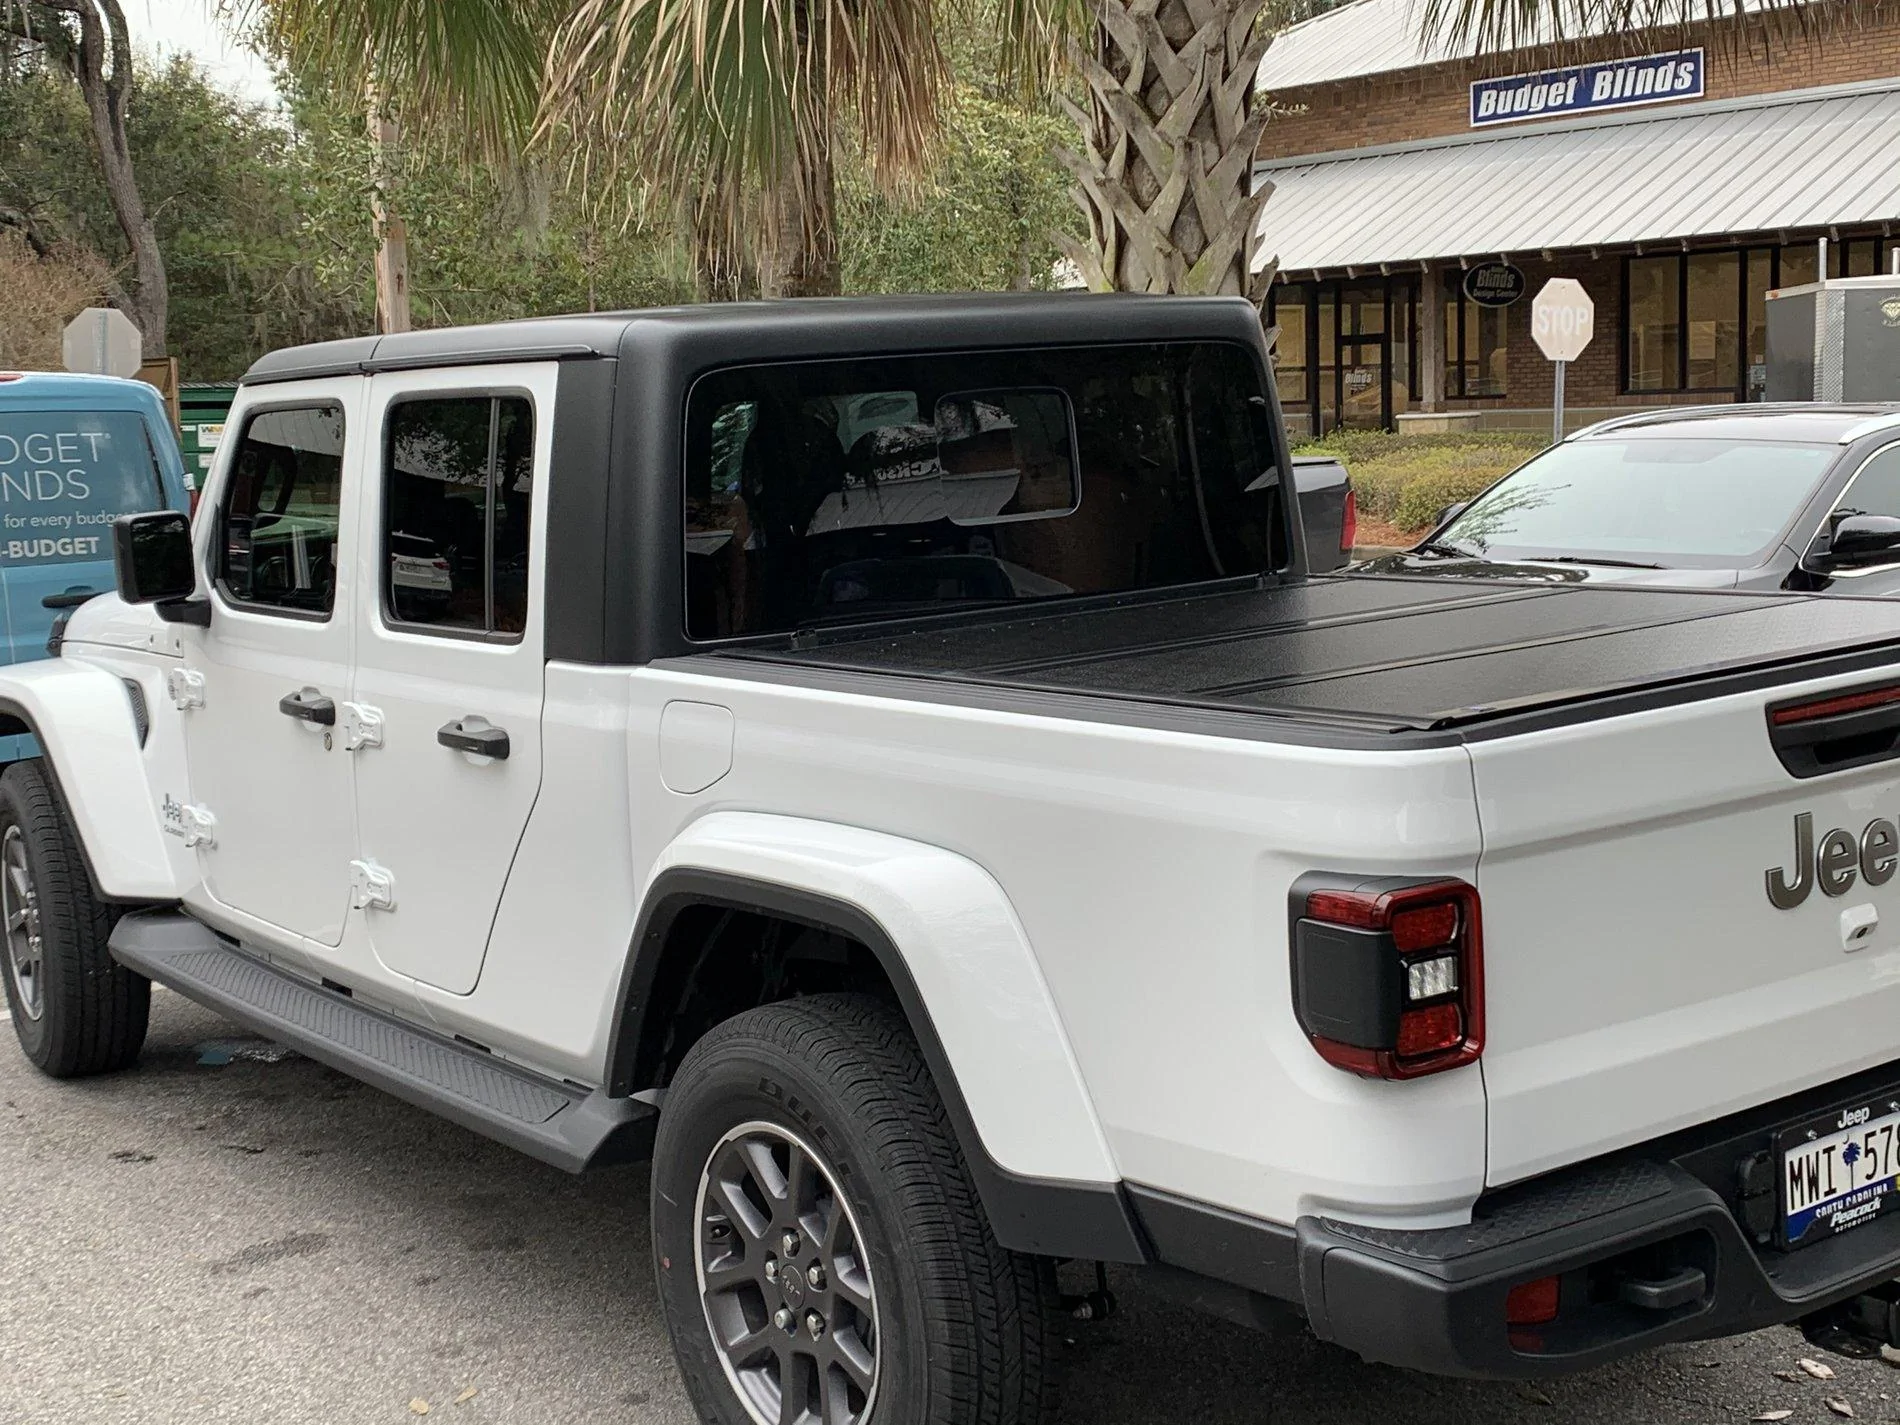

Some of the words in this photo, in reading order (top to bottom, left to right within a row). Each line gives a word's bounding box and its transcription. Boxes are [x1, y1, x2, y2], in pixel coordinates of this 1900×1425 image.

[1478, 75, 1579, 118] Budget
[1592, 60, 1695, 102] Blinds
[1476, 269, 1516, 288] Blinds
[1538, 304, 1589, 336] STOP
[4, 513, 27, 529] for
[30, 515, 72, 530] every
[1765, 811, 1900, 911] Jee
[1837, 1106, 1870, 1130] Jeep
[1789, 1144, 1838, 1211] MWI
[1864, 1123, 1900, 1181] 57
[1830, 1196, 1882, 1228] Peacock
